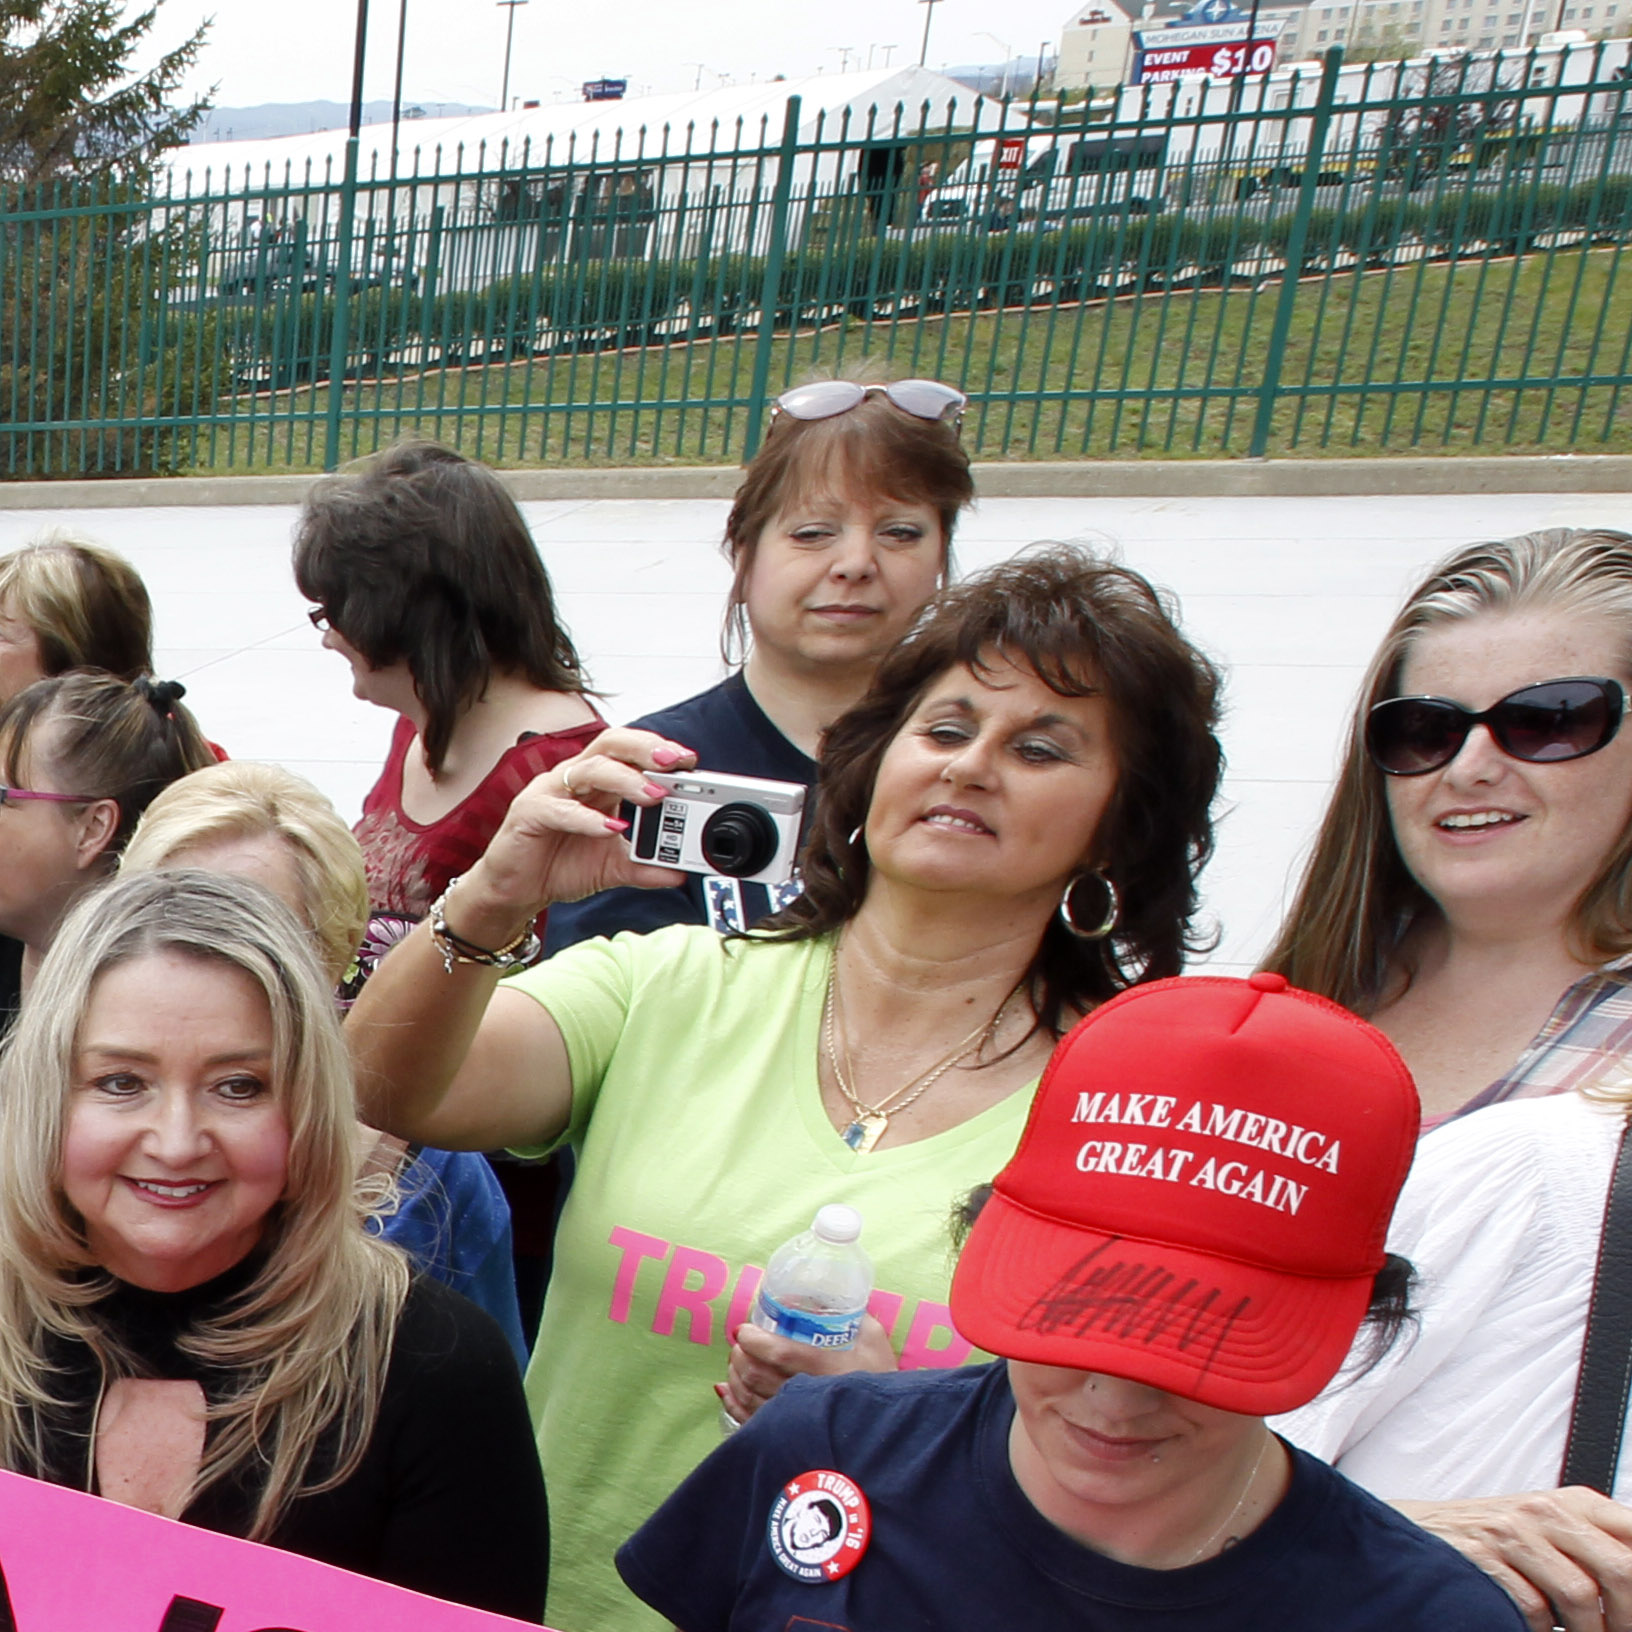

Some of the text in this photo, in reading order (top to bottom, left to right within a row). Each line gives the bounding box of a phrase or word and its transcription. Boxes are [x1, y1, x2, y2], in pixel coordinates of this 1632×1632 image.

[1144, 50, 1191, 66] EVENT
[1145, 24, 1280, 44] MOHEGAN SUN AENA
[1071, 1092, 1340, 1174] MAKE AMERICA
[1076, 1141, 1309, 1216] GREAT AGAIN
[811, 1330, 850, 1348] DEER
[770, 1497, 822, 1578] MAKE AMERICA GREAT AGAIN
[817, 1473, 861, 1508] TRUMP
[845, 1528, 864, 1550] '16
